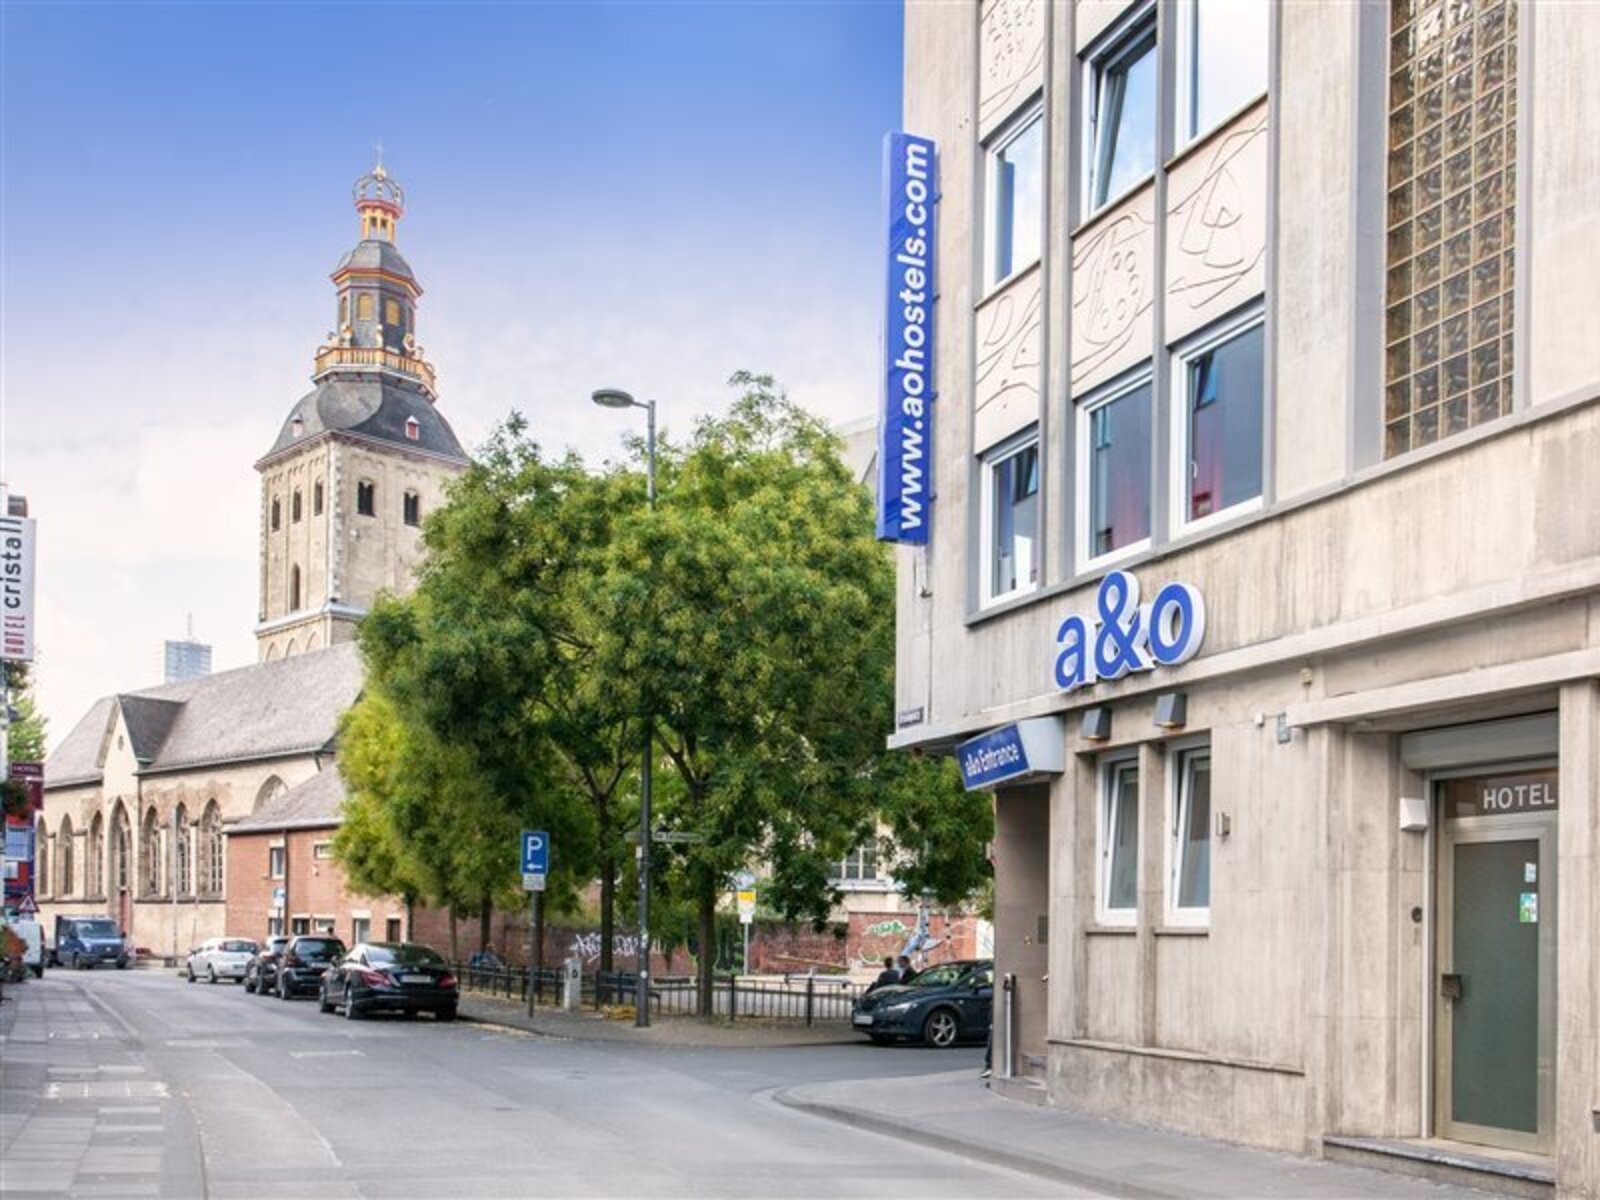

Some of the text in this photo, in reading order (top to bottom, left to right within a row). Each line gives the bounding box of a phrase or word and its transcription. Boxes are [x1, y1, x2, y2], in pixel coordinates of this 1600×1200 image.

[896, 143, 927, 530] www.aohostels.com
[0, 517, 25, 655] HOTEL cristall
[1055, 570, 1203, 691] a&o
[979, 743, 1020, 772] Entrance
[1483, 784, 1555, 809] HOTEL
[527, 836, 543, 861] P
